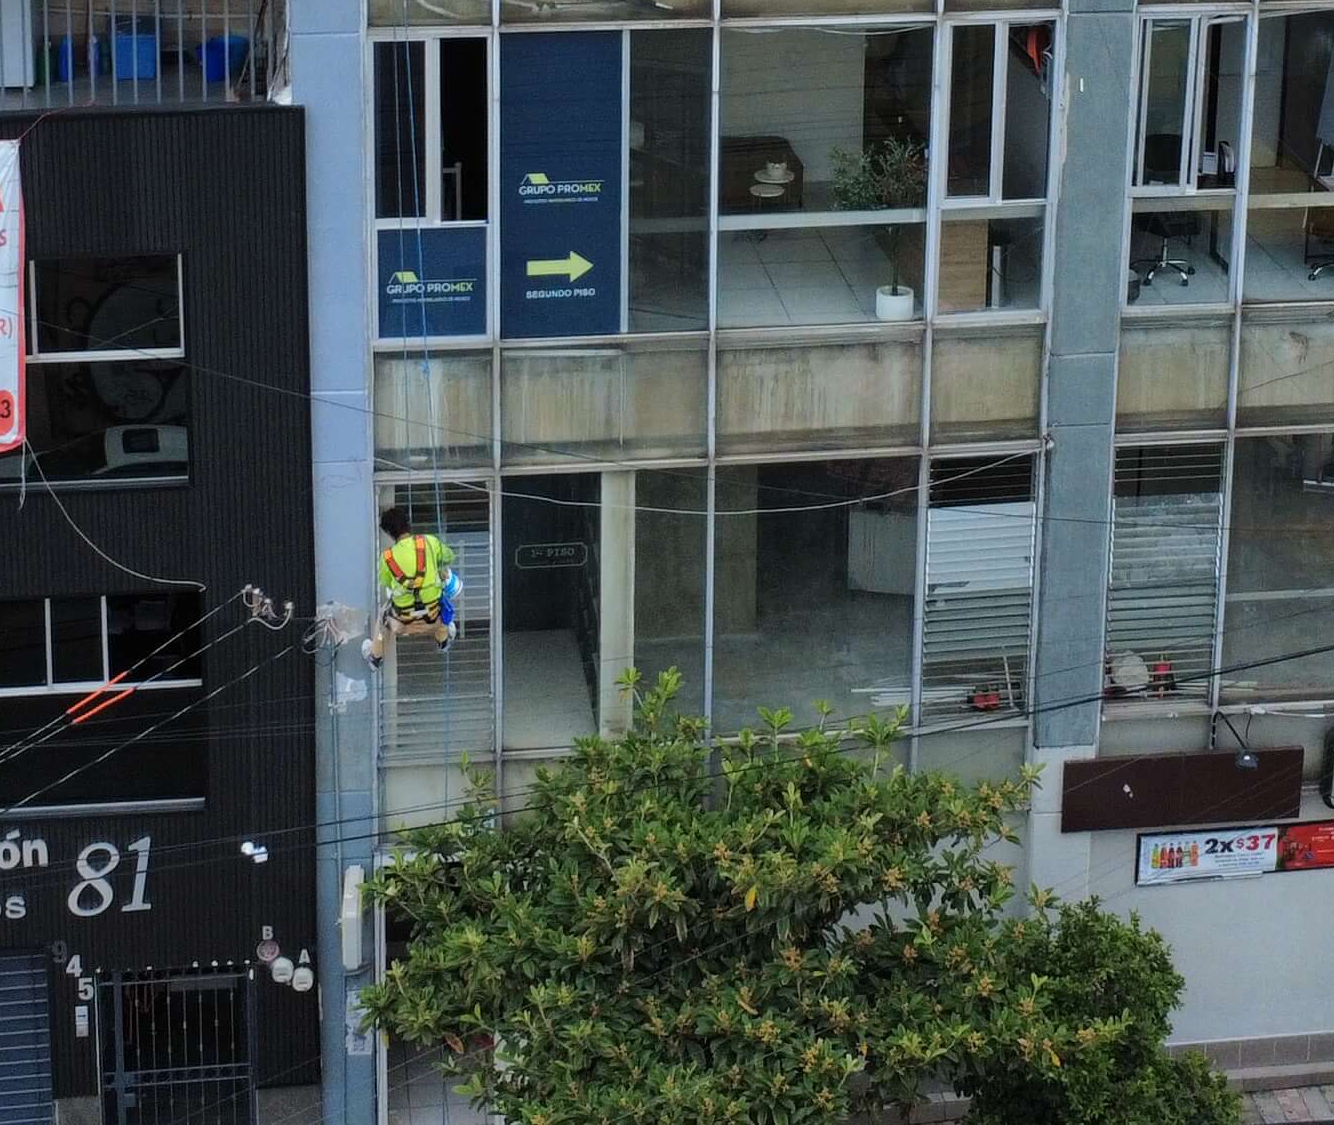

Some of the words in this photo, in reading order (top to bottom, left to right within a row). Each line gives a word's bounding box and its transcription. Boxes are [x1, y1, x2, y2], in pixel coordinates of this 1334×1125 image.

[518, 185, 555, 195] GRUPO
[557, 183, 601, 194] PROMEX
[387, 284, 425, 294] GRUPO
[427, 282, 473, 293] PROMEX
[526, 289, 572, 299] SEGUNDO
[574, 288, 596, 297] PISO
[67, 836, 152, 917] 81
[262, 925, 274, 940] B
